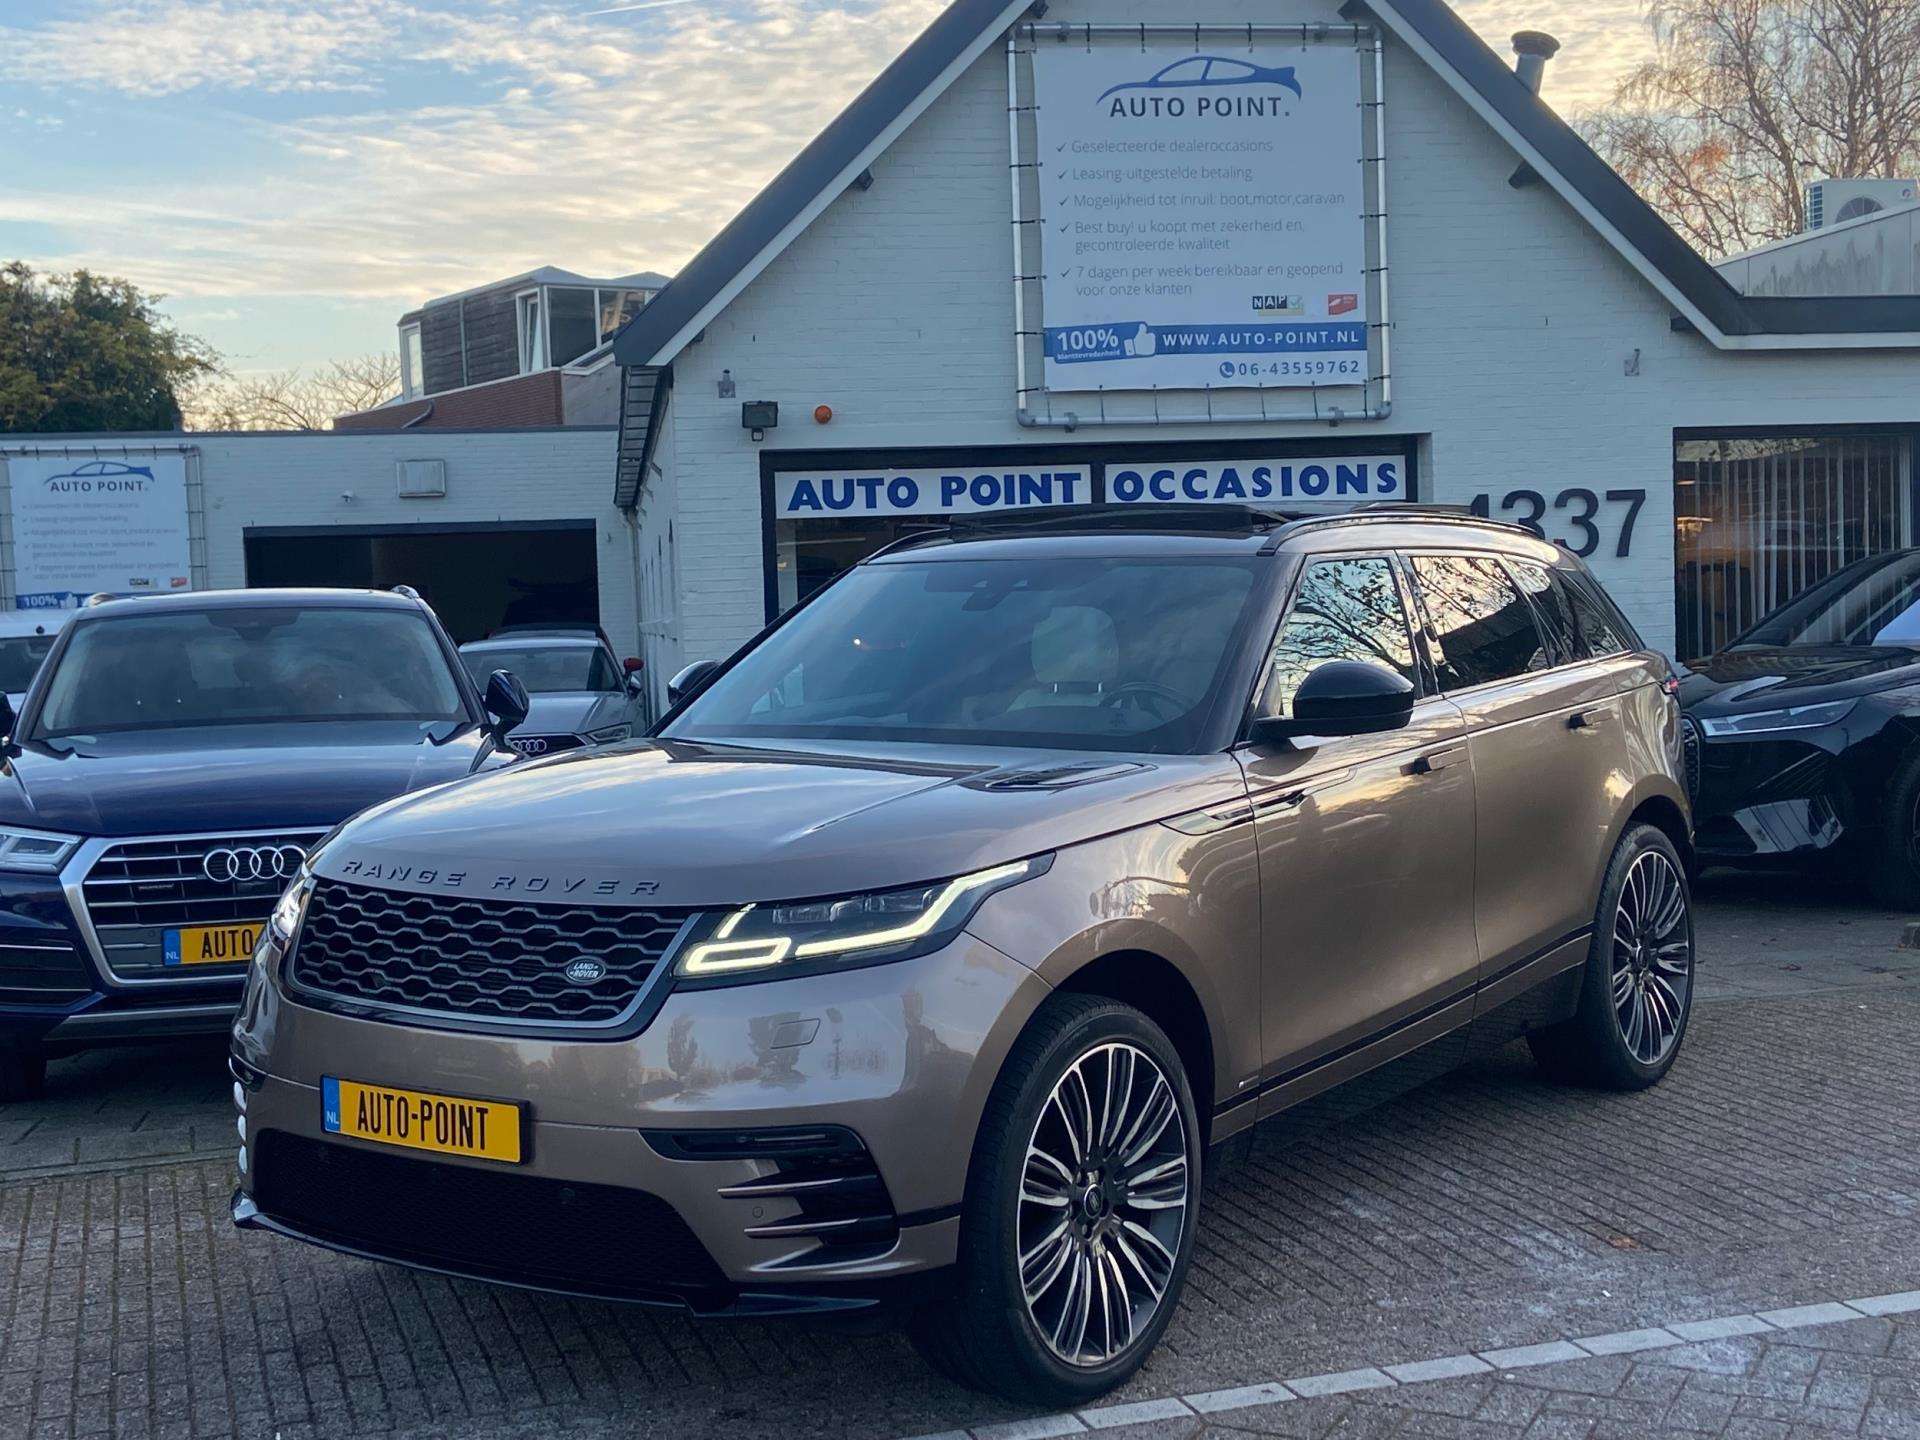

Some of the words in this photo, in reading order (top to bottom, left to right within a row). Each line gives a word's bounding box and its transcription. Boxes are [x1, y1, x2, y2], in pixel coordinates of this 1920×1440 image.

[1109, 97, 1185, 117] AUTO
[1197, 96, 1290, 117] POINT.
[1071, 140, 1166, 153] Geselecteerde
[1169, 139, 1274, 153] dealeroccasions
[1201, 165, 1253, 182] betaling
[1074, 193, 1155, 209] Mogelijkheid
[1158, 194, 1176, 206] tot
[1075, 221, 1103, 234] Best
[1138, 223, 1146, 233] u
[1150, 219, 1188, 234] koopt
[1191, 220, 1216, 232] met
[1220, 219, 1282, 232] zekerheid
[1075, 238, 1174, 255] gecontroleerde
[1178, 237, 1231, 250] kwaliteit
[1076, 266, 1084, 278] 7
[1088, 265, 1128, 281] dagen
[1132, 267, 1154, 281] per
[1158, 264, 1191, 277] week
[1195, 263, 1262, 277] bereikbaar
[1267, 265, 1283, 276] en
[1287, 262, 1343, 278] geopend
[1076, 285, 1105, 297] voor
[1109, 284, 1141, 295] onze
[1145, 282, 1192, 296] klanten
[1253, 295, 1287, 309] NAP
[1057, 328, 1119, 351] 100%
[1163, 330, 1360, 347] WWW.AUTO-POINT.NL
[1238, 360, 1360, 376] 06-43559762
[50, 481, 92, 492] AUTO
[787, 476, 919, 511] AUTO
[941, 472, 1081, 507] POINT
[1113, 462, 1398, 502] OCCASIONS
[24, 595, 58, 607] 100%
[342, 860, 467, 887] RANGE
[490, 875, 662, 896] ROVER
[165, 951, 180, 961] NL
[326, 1111, 340, 1125] NL
[357, 1090, 489, 1150] AUTO-POINT
